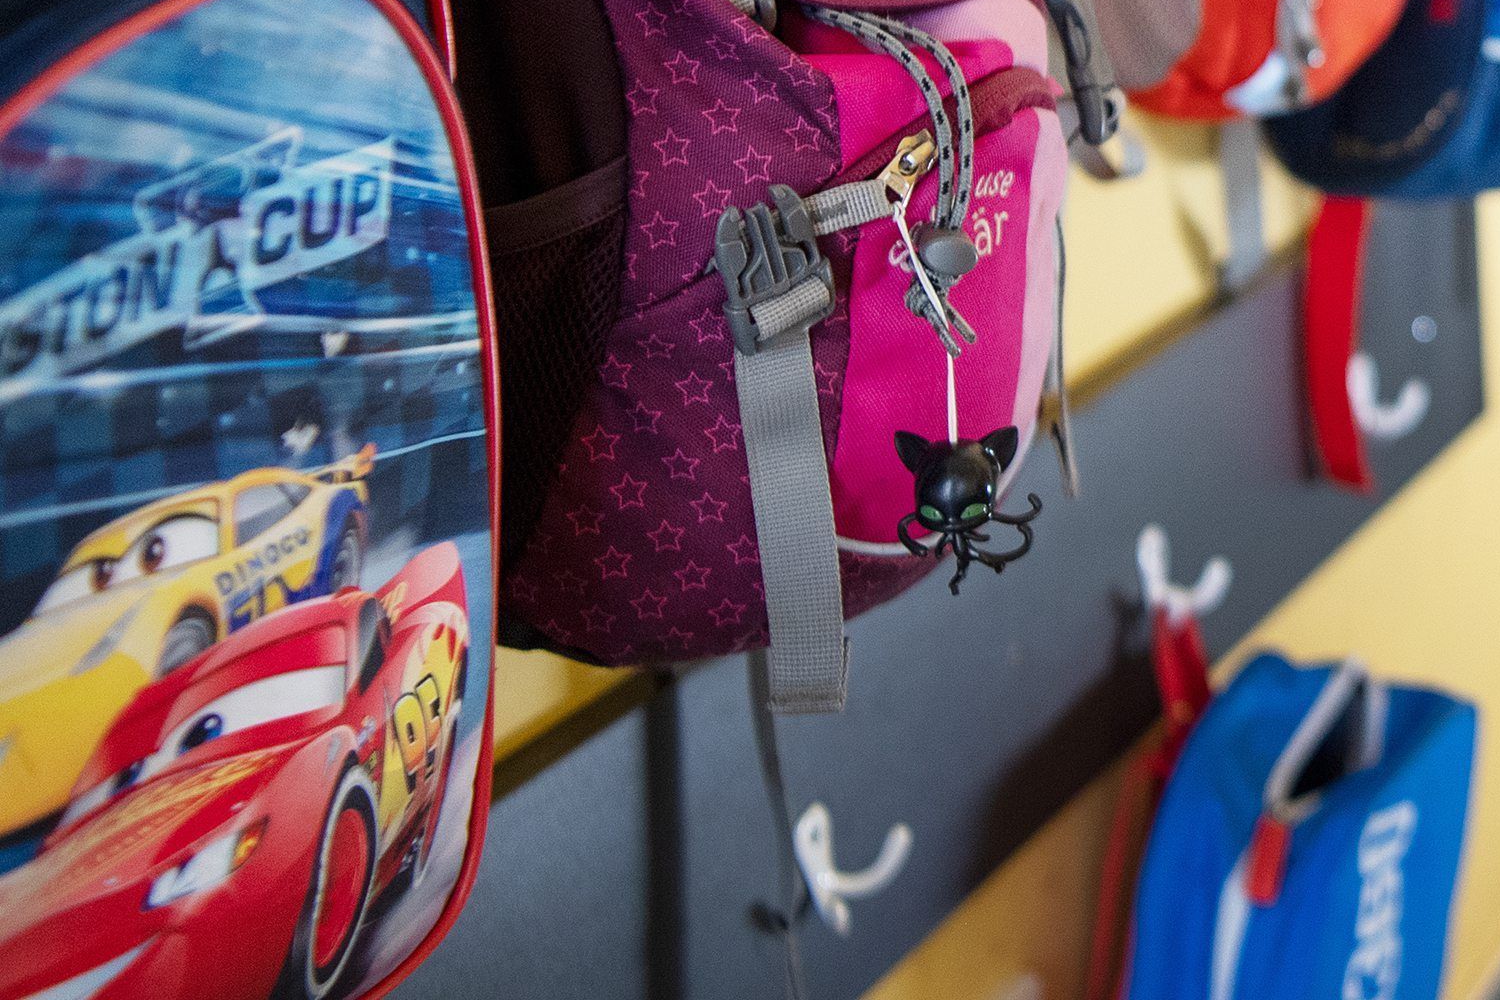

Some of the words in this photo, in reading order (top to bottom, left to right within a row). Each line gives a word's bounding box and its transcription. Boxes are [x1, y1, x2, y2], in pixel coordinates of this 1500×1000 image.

[254, 173, 381, 266] CUP
[971, 206, 1009, 256] är
[216, 526, 311, 596] DINOCO
